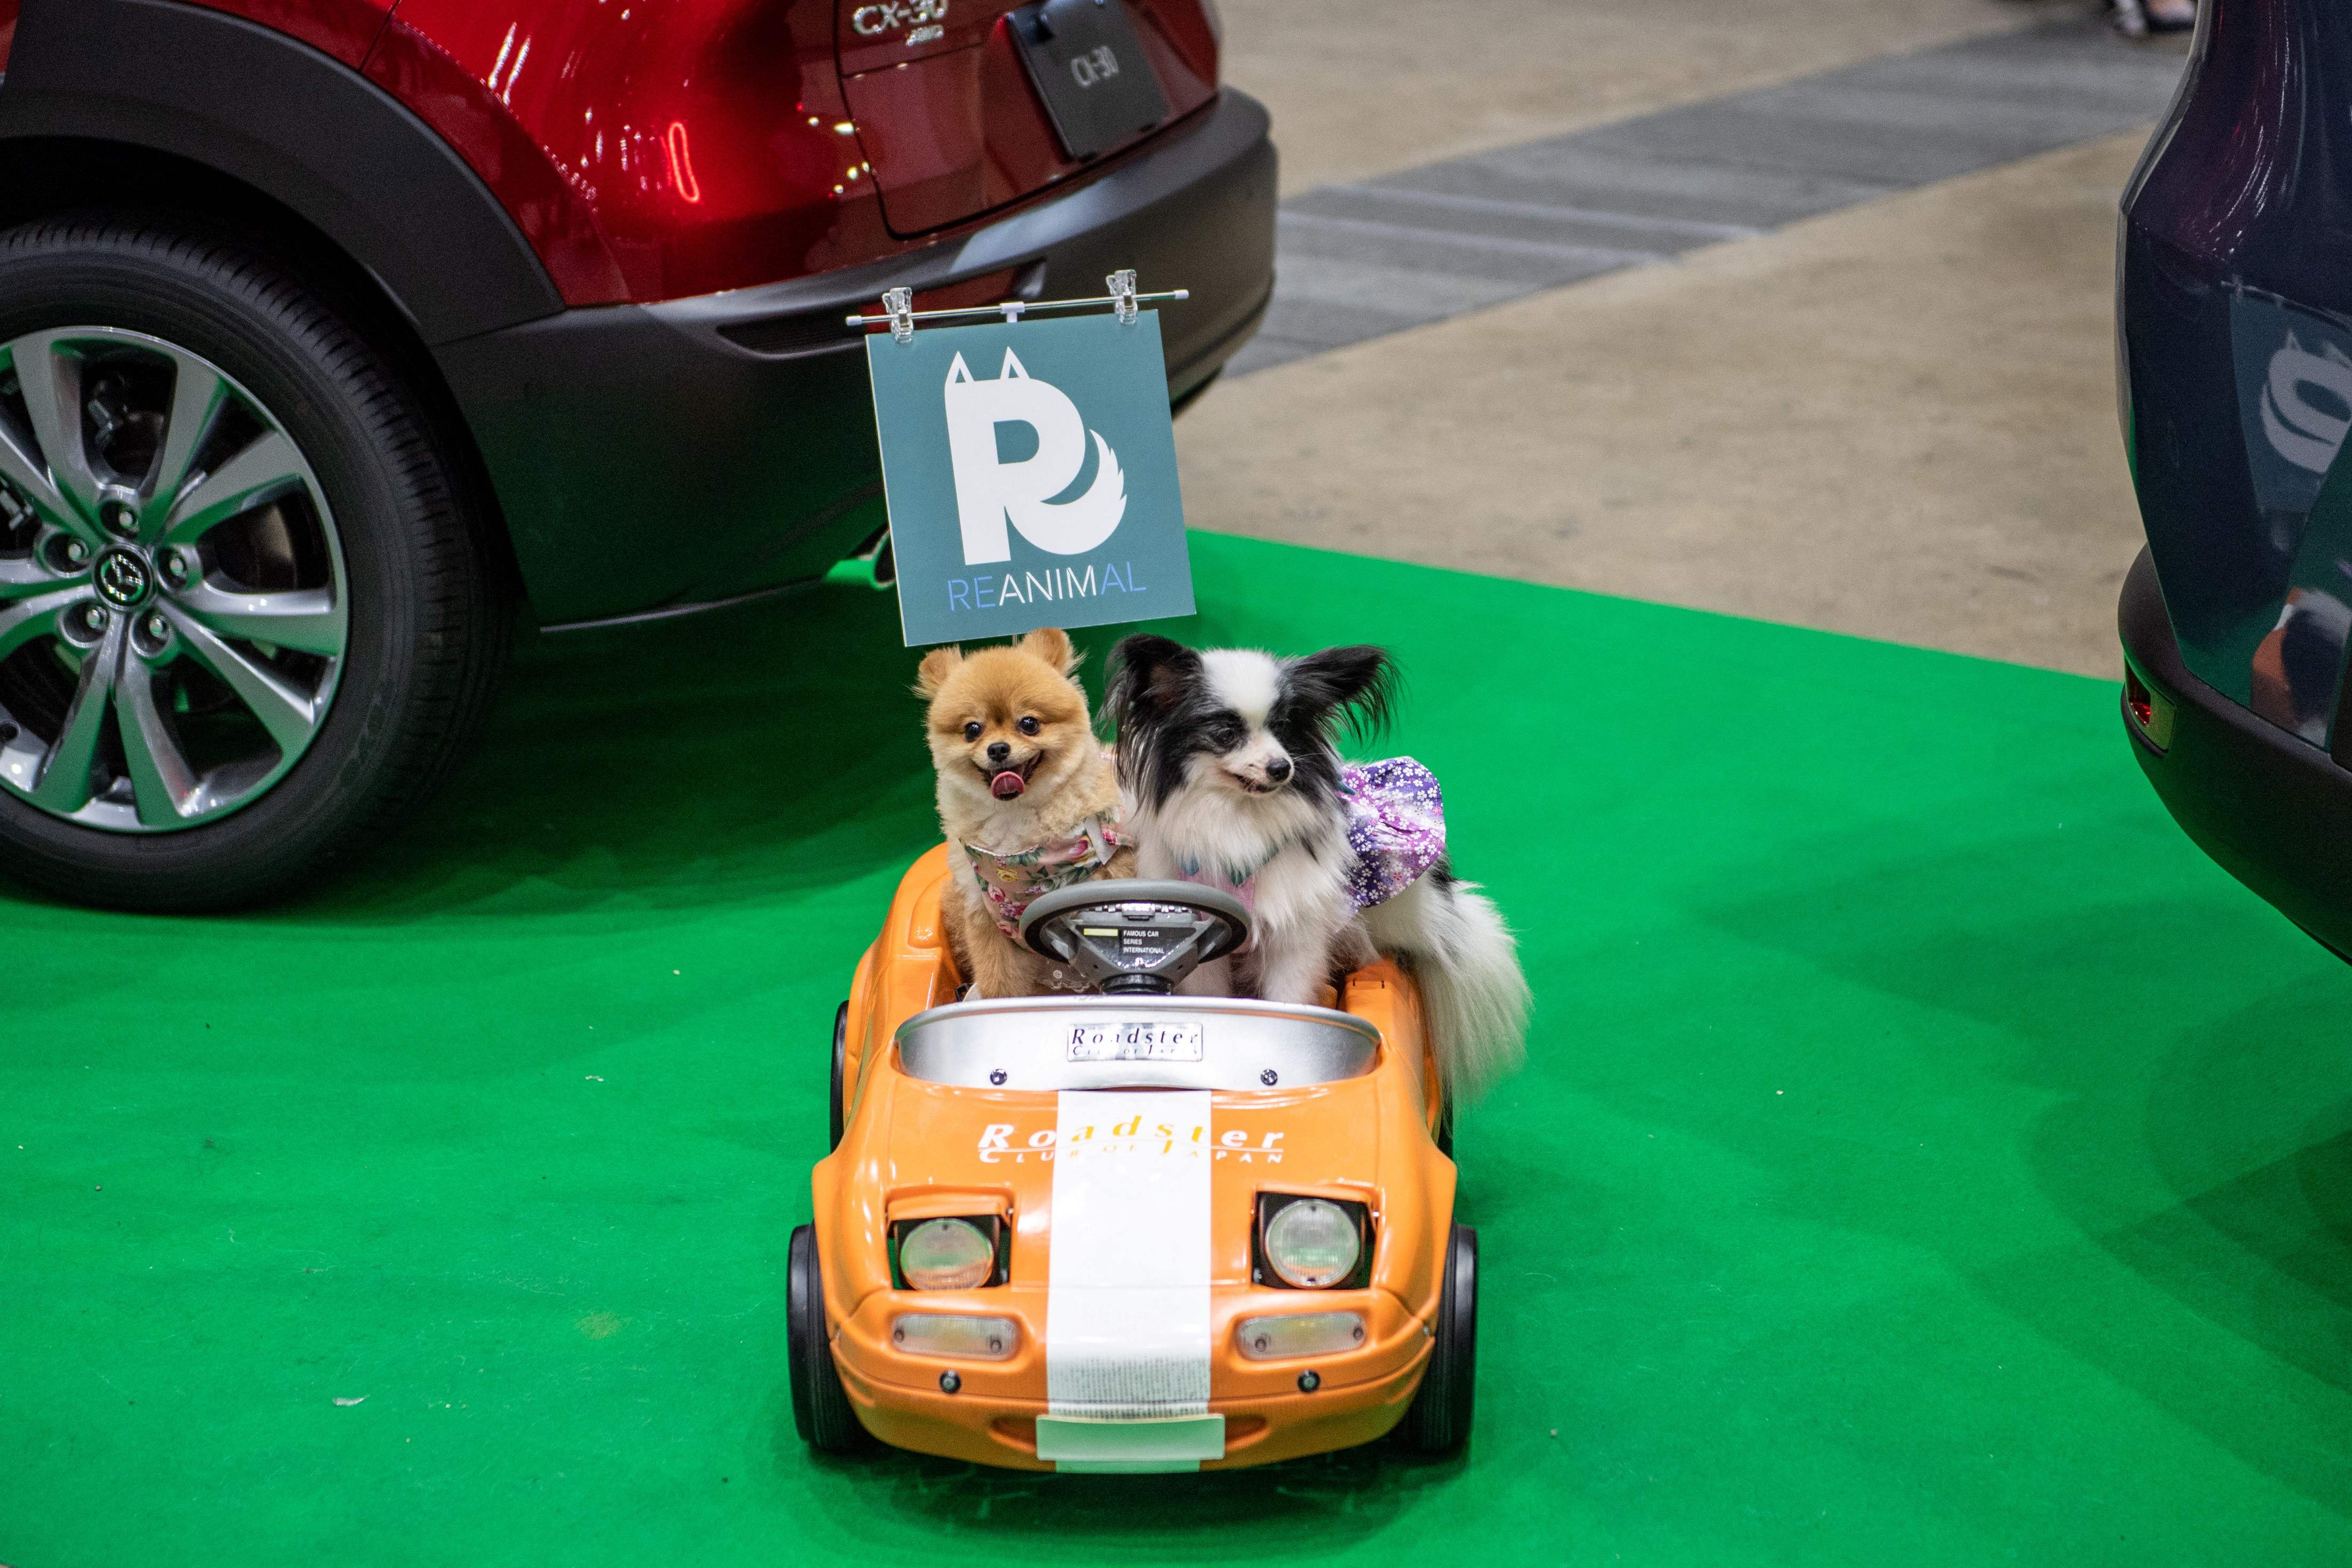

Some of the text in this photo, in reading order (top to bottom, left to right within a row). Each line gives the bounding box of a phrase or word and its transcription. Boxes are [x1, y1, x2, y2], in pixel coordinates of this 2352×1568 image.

[853, 0, 949, 36] CX-30
[948, 561, 1147, 611] REANIMAL
[978, 1115, 1285, 1149] Roadster
